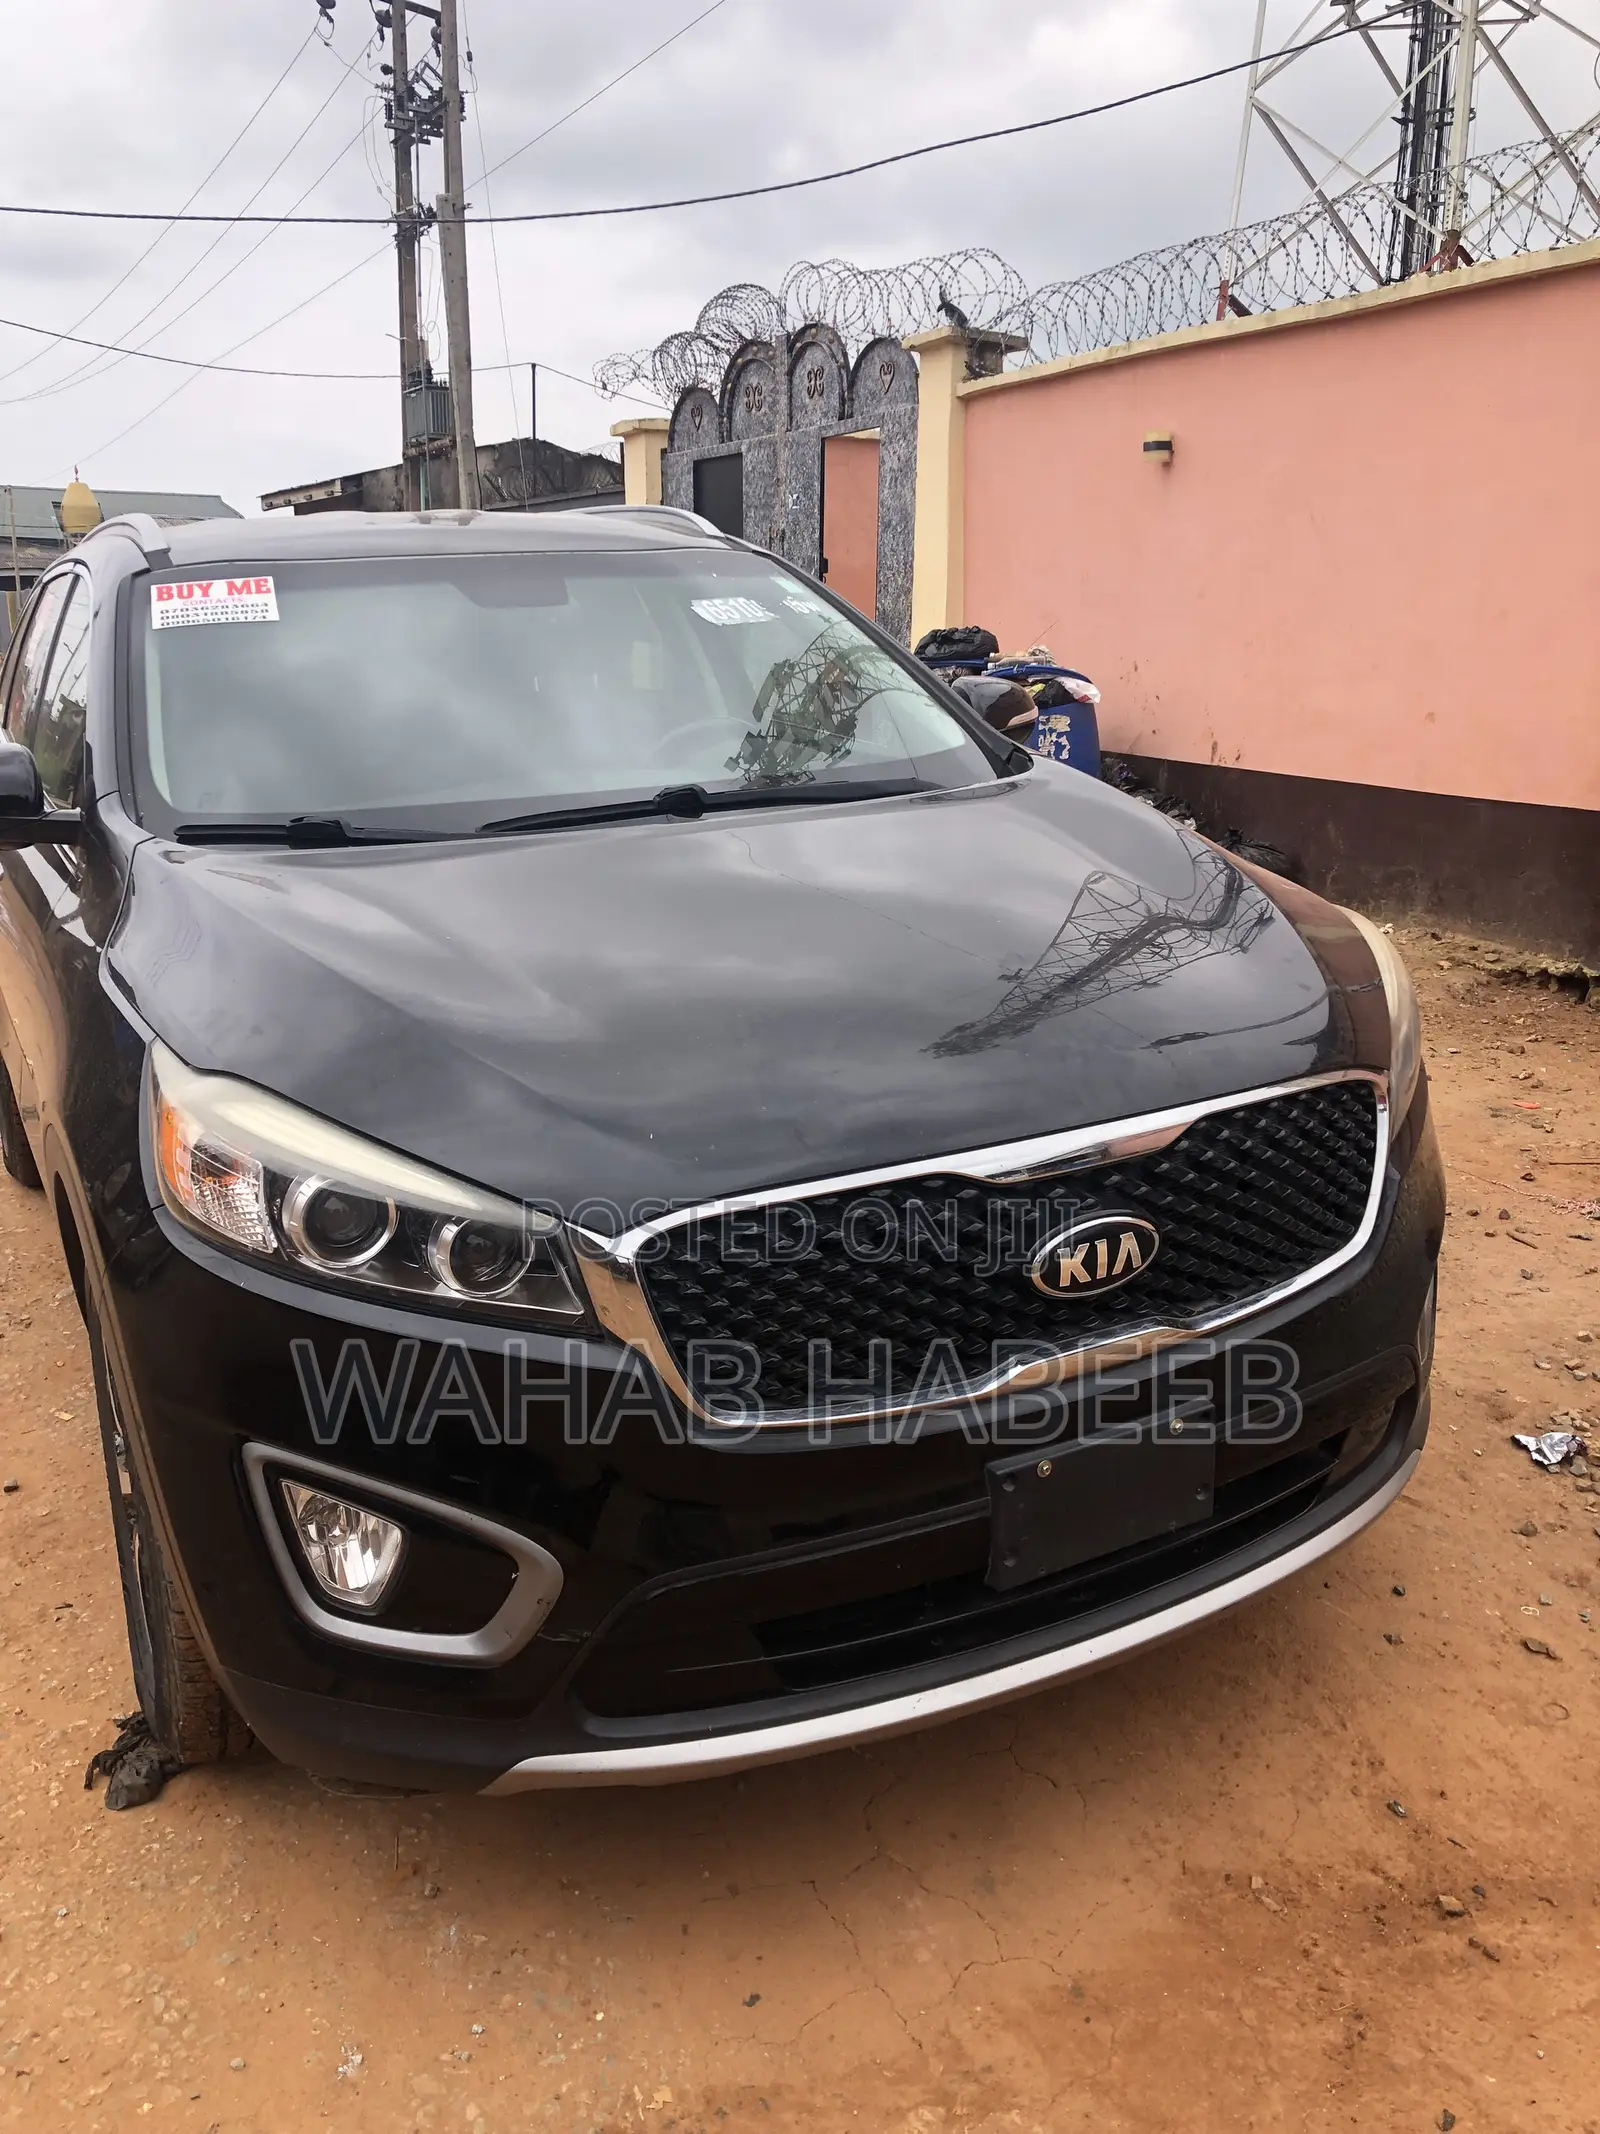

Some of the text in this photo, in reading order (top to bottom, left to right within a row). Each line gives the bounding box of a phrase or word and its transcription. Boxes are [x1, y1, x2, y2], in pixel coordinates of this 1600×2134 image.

[155, 578, 271, 602] BUY ME
[1057, 1230, 1144, 1287] KIA
